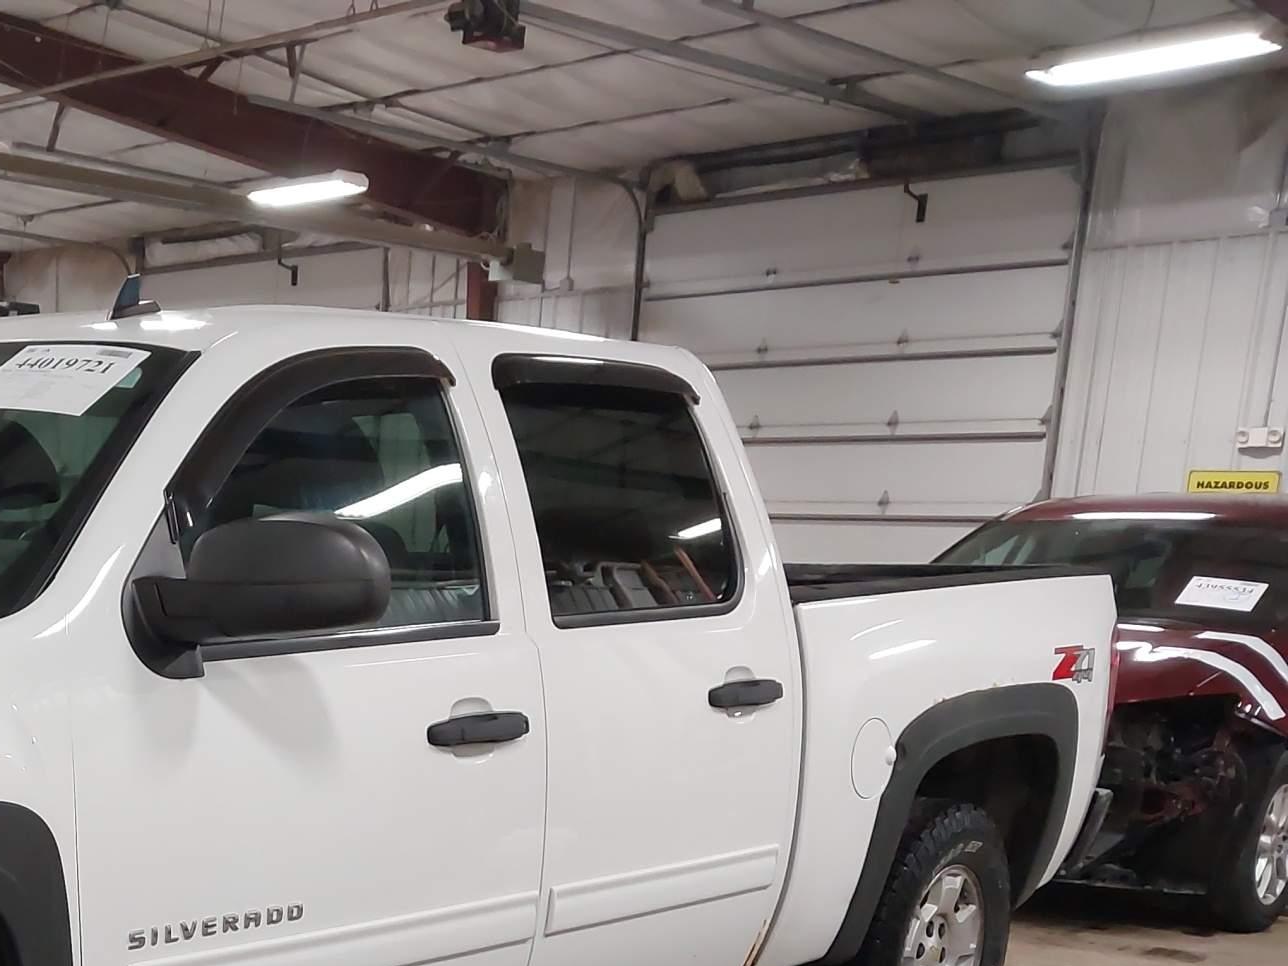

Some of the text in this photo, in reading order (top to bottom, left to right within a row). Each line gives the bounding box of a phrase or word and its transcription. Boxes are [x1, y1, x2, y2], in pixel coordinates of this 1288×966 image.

[15, 357, 116, 374] 44019721
[1196, 480, 1270, 490] HAZARDOUS
[127, 902, 304, 950] SILVERADO
